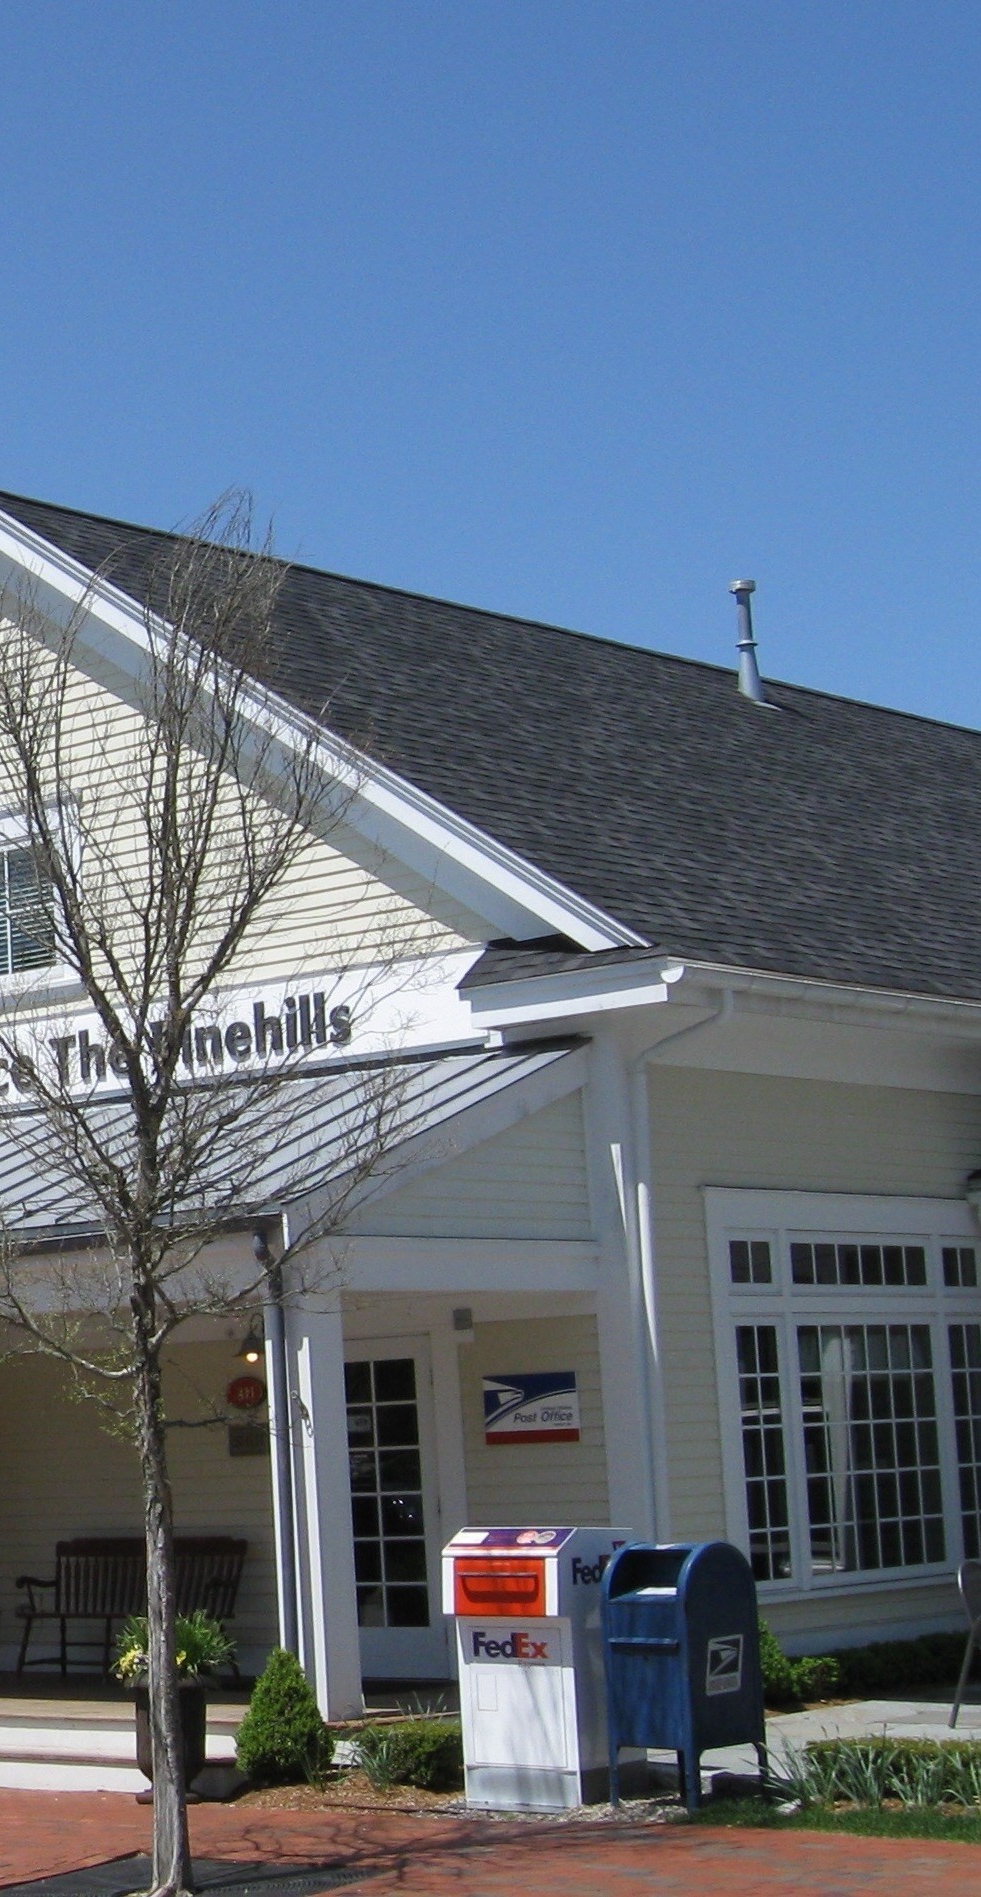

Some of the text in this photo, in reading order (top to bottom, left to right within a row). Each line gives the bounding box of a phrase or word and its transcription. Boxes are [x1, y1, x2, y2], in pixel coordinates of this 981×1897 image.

[49, 1030, 131, 1083] The
[513, 1410, 574, 1423] Post Office
[571, 1554, 611, 1585] Fed
[472, 1631, 548, 1659] FedEx
